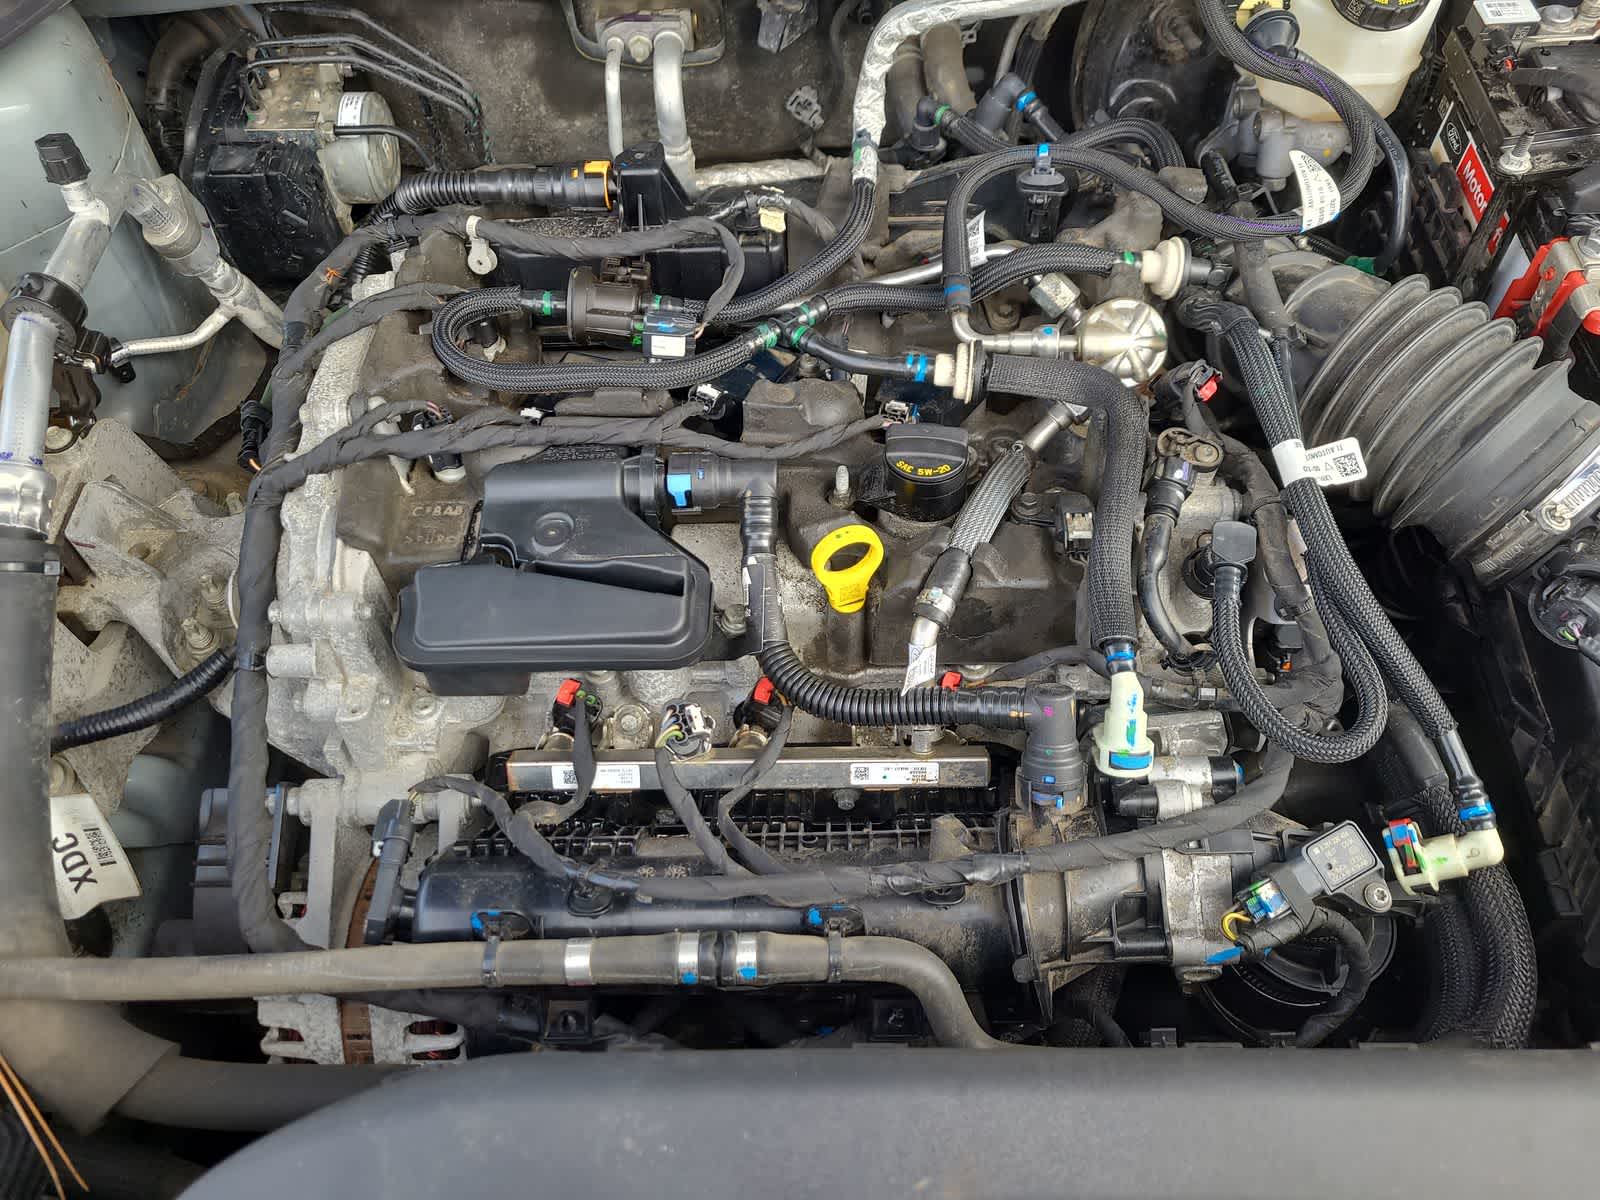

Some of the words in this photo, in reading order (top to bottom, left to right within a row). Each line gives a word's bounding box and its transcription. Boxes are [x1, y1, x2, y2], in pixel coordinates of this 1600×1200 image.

[896, 460, 914, 473] SAE
[918, 464, 951, 476] 5W-20
[52, 832, 98, 894] XDC
